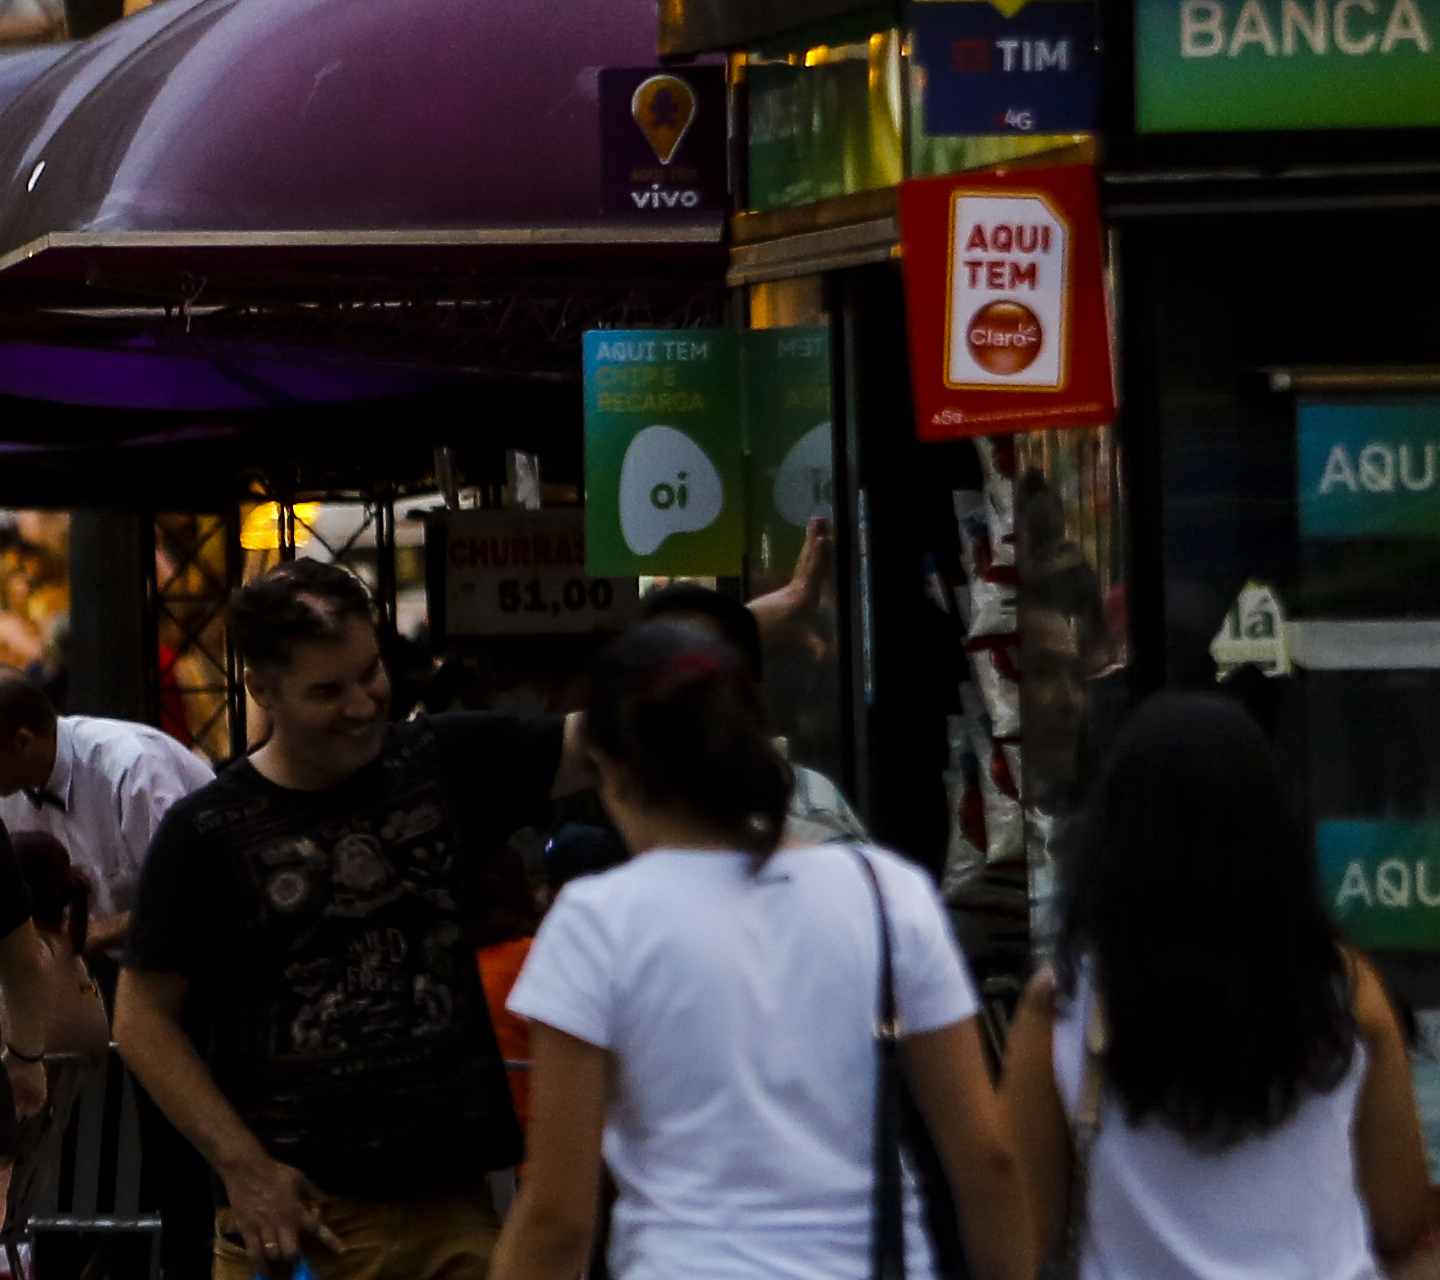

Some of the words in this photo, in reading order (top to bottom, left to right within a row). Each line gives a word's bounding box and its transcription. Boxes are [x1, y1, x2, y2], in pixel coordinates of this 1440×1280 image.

[994, 39, 1070, 72] TIM
[630, 183, 699, 209] vivo
[965, 223, 1054, 254] AQUI
[964, 260, 1038, 291] TEM
[595, 340, 656, 362] AQUI
[663, 340, 710, 362] TEM
[969, 327, 1028, 349] Claro
[1318, 441, 1440, 495] AQU
[648, 470, 691, 511] oi
